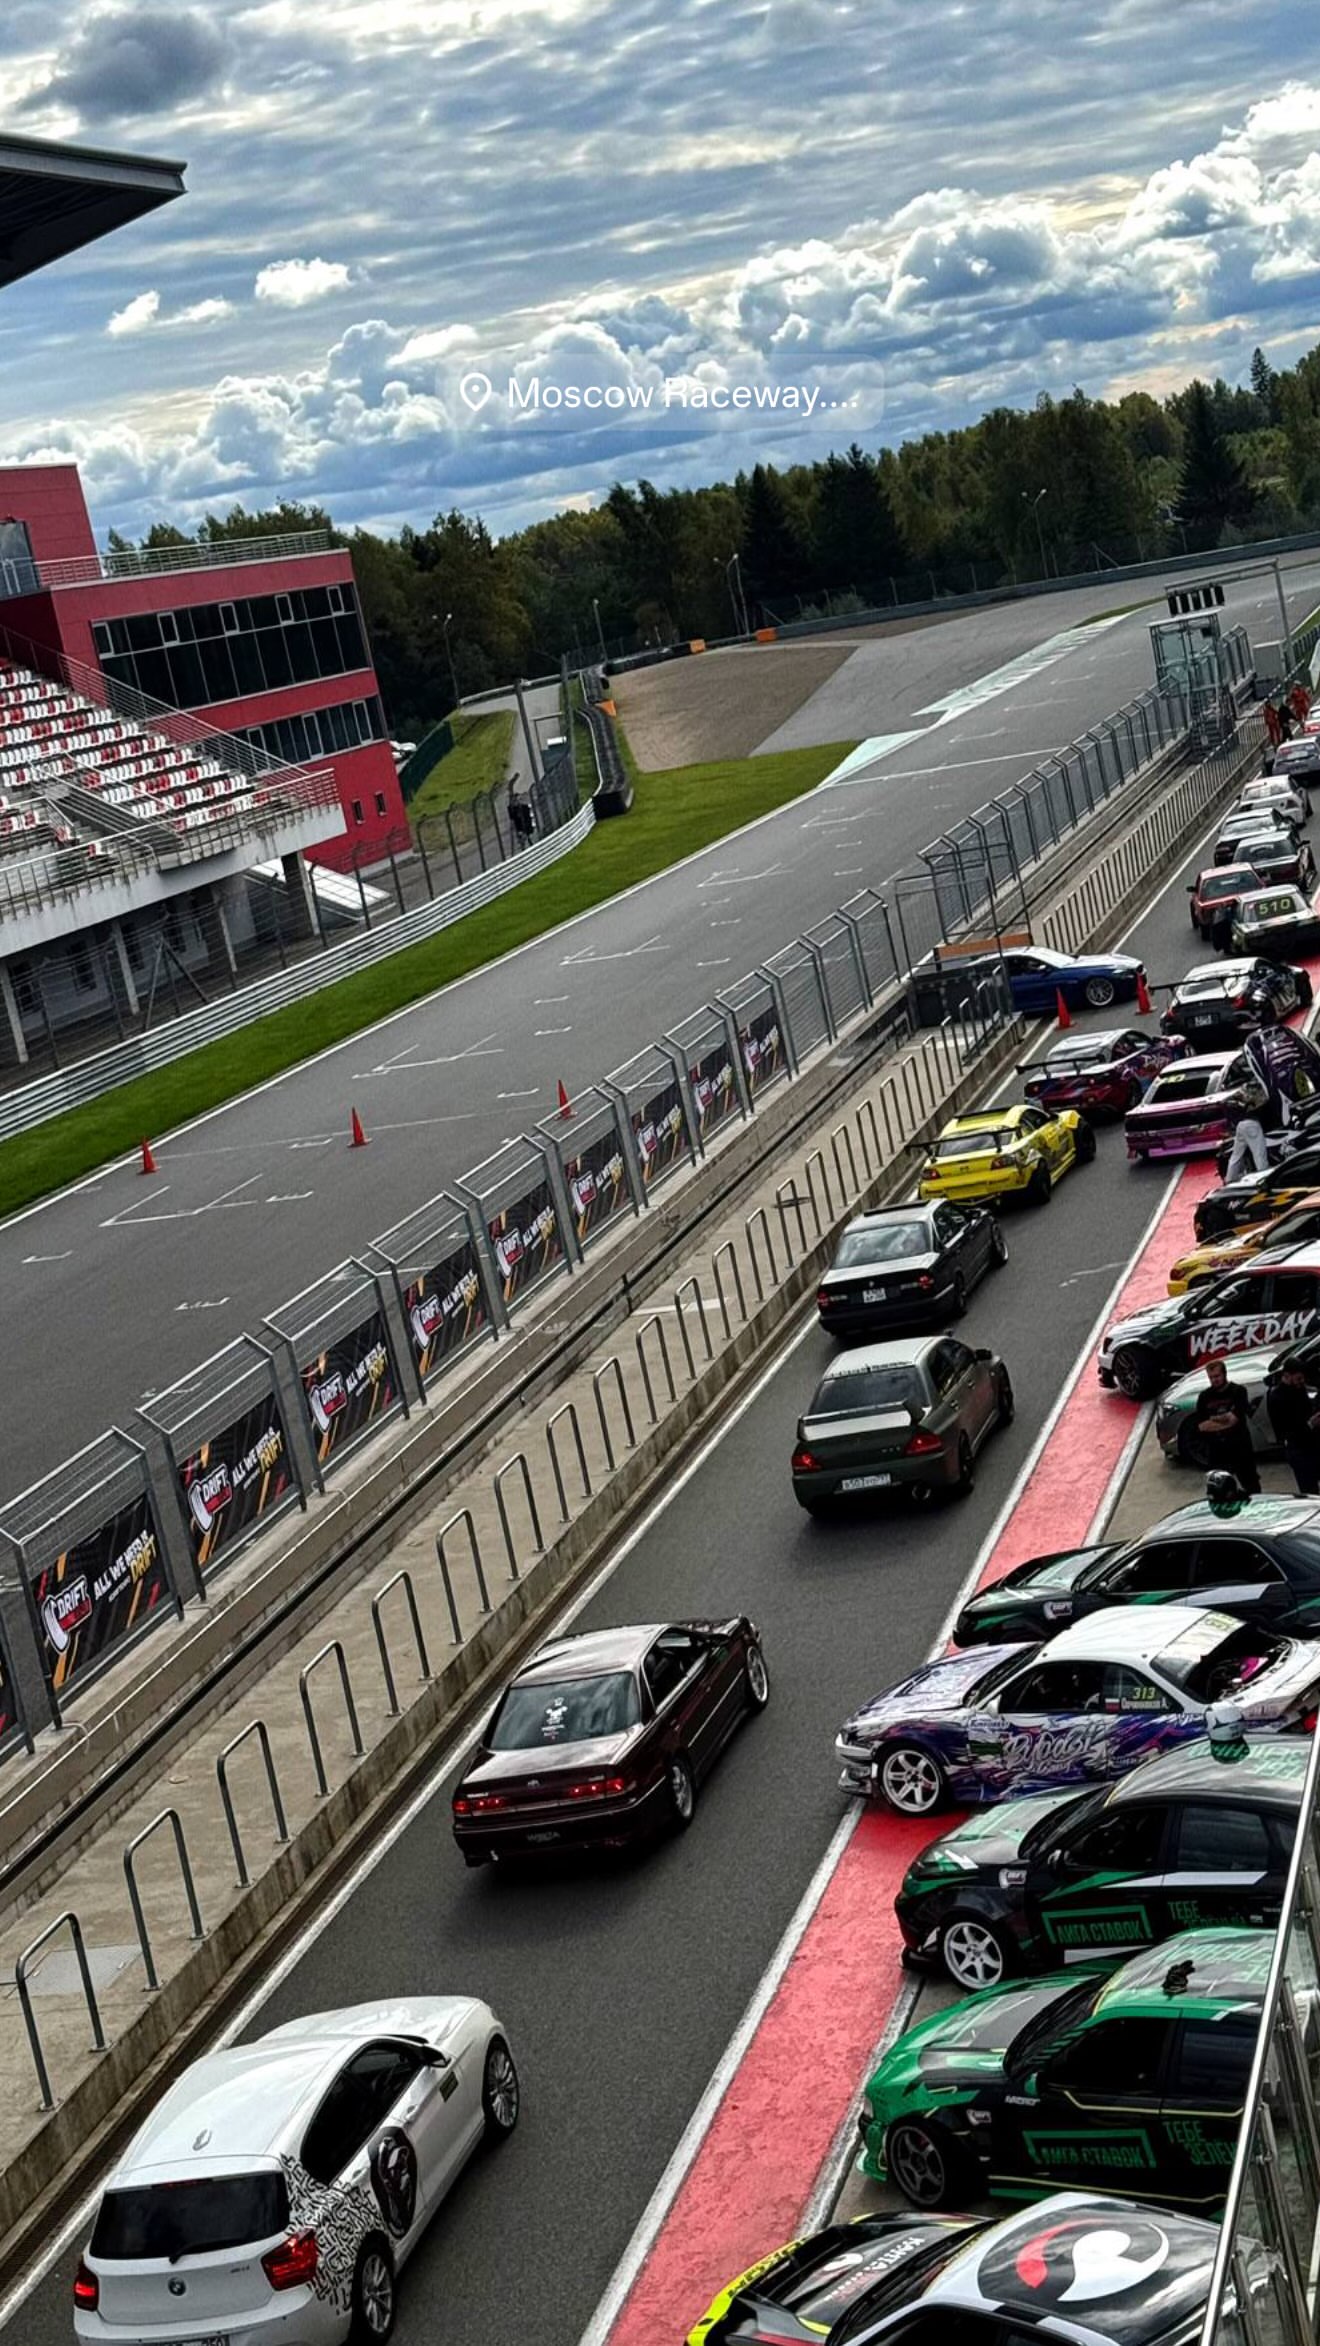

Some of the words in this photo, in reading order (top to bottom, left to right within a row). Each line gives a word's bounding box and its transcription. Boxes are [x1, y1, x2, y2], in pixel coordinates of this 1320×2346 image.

[1259, 898, 1291, 915] 510
[202, 1469, 226, 1502] DRIFT
[93, 1570, 112, 1600] ALL
[109, 1555, 126, 1581] WE
[56, 1581, 86, 1620] DRIFT
[1133, 1687, 1156, 1699] 313
[1056, 1924, 1092, 1944] ЛИГА
[1089, 1920, 1145, 1942] СТАВОК
[1162, 2120, 1206, 2144] ТЕБЕ
